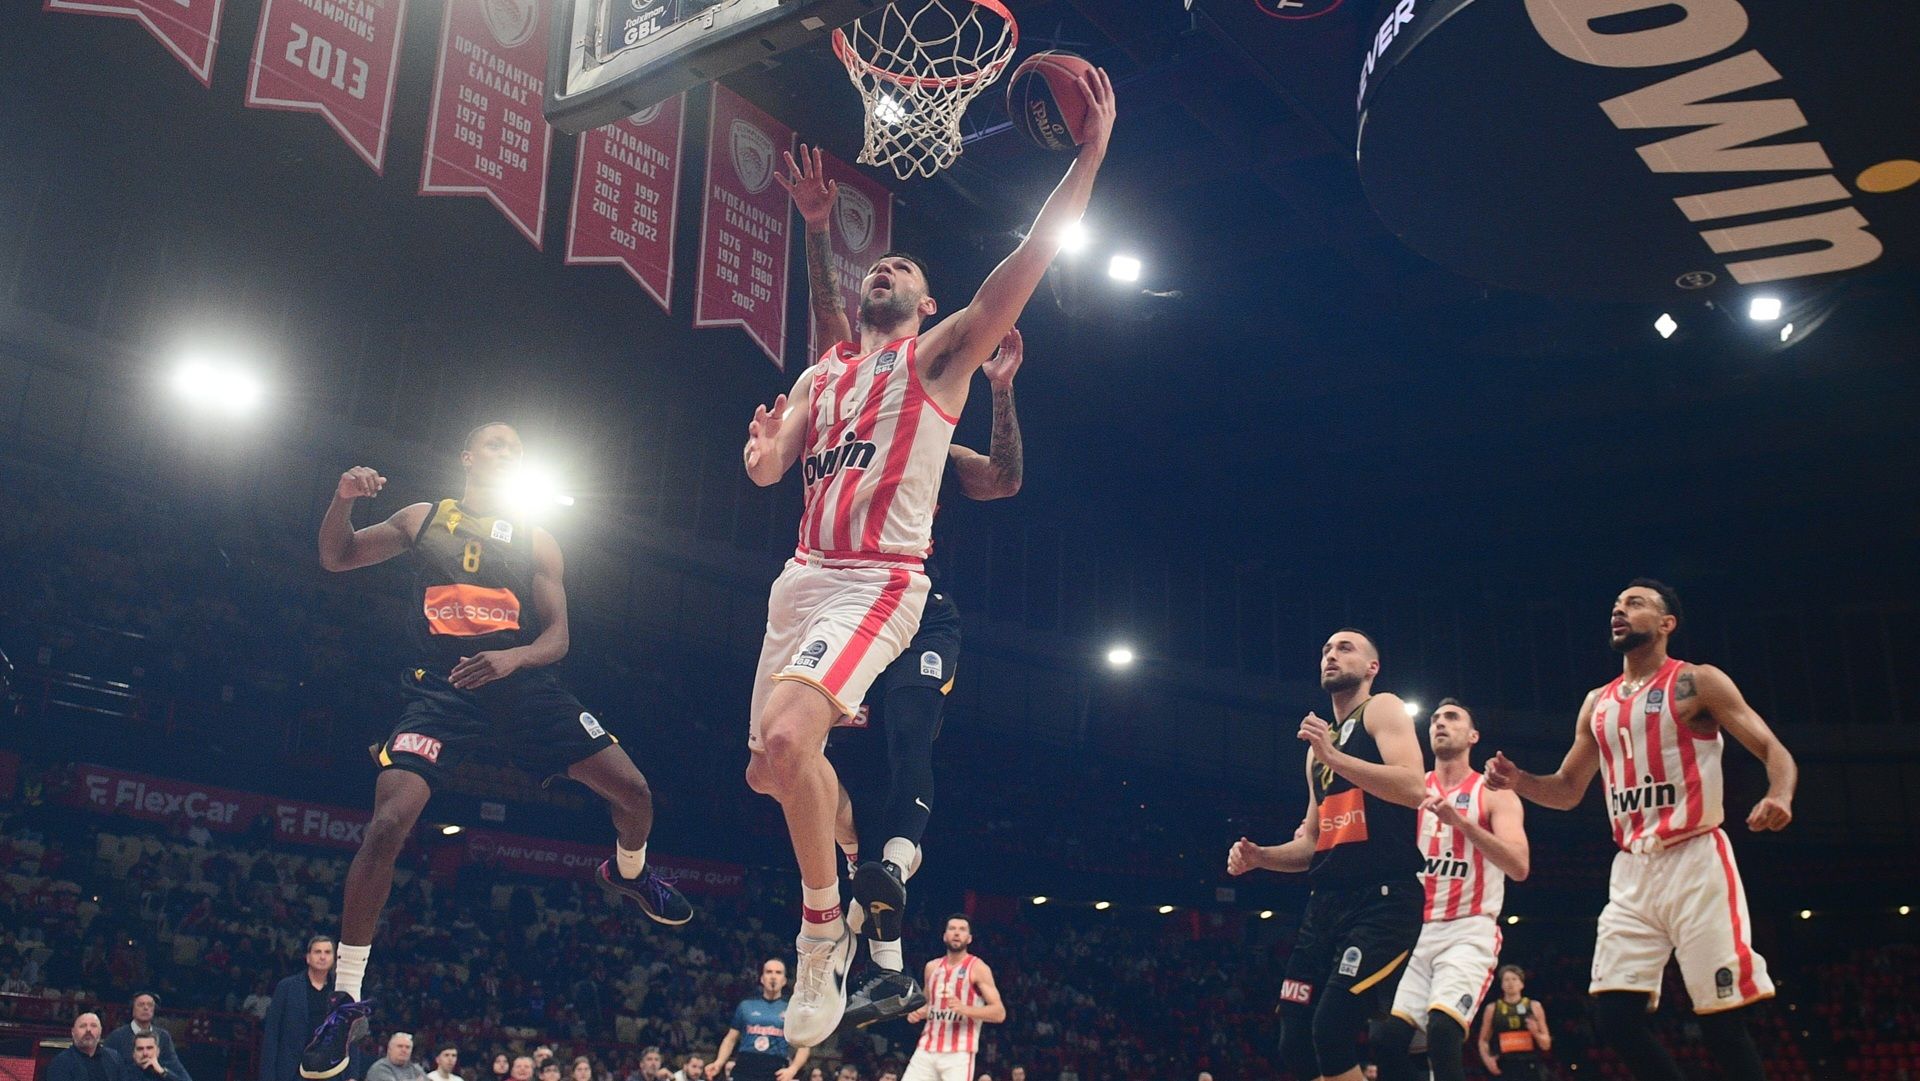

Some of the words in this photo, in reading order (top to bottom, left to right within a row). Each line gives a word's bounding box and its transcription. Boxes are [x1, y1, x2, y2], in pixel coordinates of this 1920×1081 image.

[624, 17, 661, 45] GBL
[285, 22, 369, 100] 2013
[1357, 0, 1415, 111] EVER
[468, 62, 528, 106] ΕΛΛΑΔΑΣ
[456, 104, 486, 130] 1976
[501, 127, 530, 153] 1978
[458, 84, 488, 112] 1949
[503, 108, 531, 134] 1960
[454, 123, 483, 150] 1993
[498, 145, 528, 172] 1994
[474, 154, 503, 180] 1995
[604, 139, 657, 179] ΕΛΛΑΔΑΣ
[594, 180, 620, 204] 2012
[633, 200, 658, 224] 2015
[595, 161, 622, 186] 1996
[634, 182, 660, 205] 1997
[592, 198, 618, 223] 2016
[631, 218, 657, 242] 2022
[610, 225, 636, 250] 2023
[725, 209, 770, 244] ΕΛΛΑΔΑΣ
[717, 246, 740, 269] 1978
[750, 265, 773, 286] 1980
[718, 229, 741, 251] 1976
[752, 248, 774, 269] 1977
[716, 264, 739, 286] 1994
[750, 281, 771, 303] 1997
[731, 290, 755, 312] 2002
[462, 541, 482, 573] 8
[424, 602, 520, 623] betsson
[394, 733, 443, 761] AVIS
[1619, 726, 1633, 759] 1
[115, 780, 240, 824] FlexCar
[1321, 809, 1366, 832] sson
[497, 845, 559, 863] NEVER
[1423, 851, 1469, 878] win
[705, 869, 742, 886] QUIT
